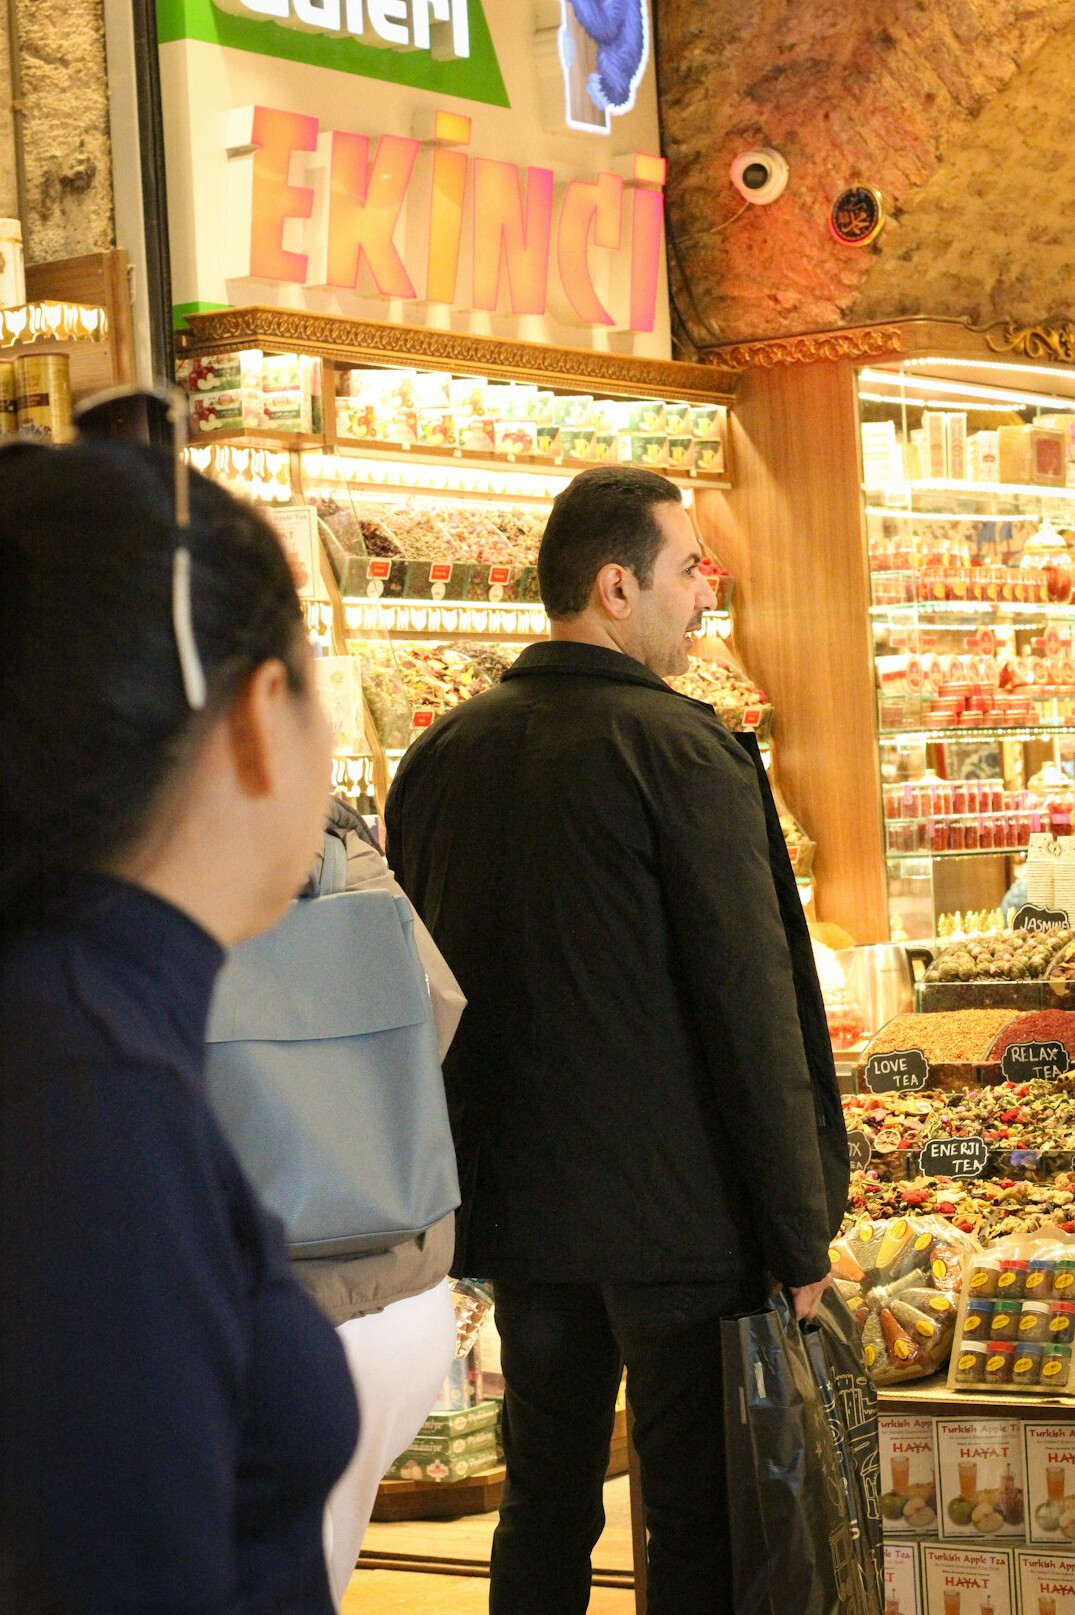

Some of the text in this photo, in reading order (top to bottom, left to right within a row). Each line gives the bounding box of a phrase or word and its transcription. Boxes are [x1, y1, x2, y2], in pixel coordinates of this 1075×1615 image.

[238, 0, 470, 58] aeri
[1010, 1046, 1059, 1062] RELAX
[873, 1058, 908, 1075] LOVE
[1032, 1064, 1062, 1079] TEA
[892, 1073, 919, 1088] TEA
[931, 1142, 980, 1158] ENERJI
[952, 1159, 983, 1173] TEA
[879, 1419, 910, 1429] urkish
[941, 1424, 977, 1434] Turkish
[980, 1424, 1007, 1435] Apple
[1029, 1428, 1066, 1438] Turkish
[892, 1441, 933, 1454] HAYA
[960, 1446, 1010, 1460] HAYAT
[895, 1550, 911, 1559] Tea
[927, 1551, 1006, 1565] Turkish Apple Tea
[1021, 1558, 1057, 1569] Turkish
[944, 1575, 990, 1590] HAYAT
[1040, 1582, 1075, 1597] HAYA
